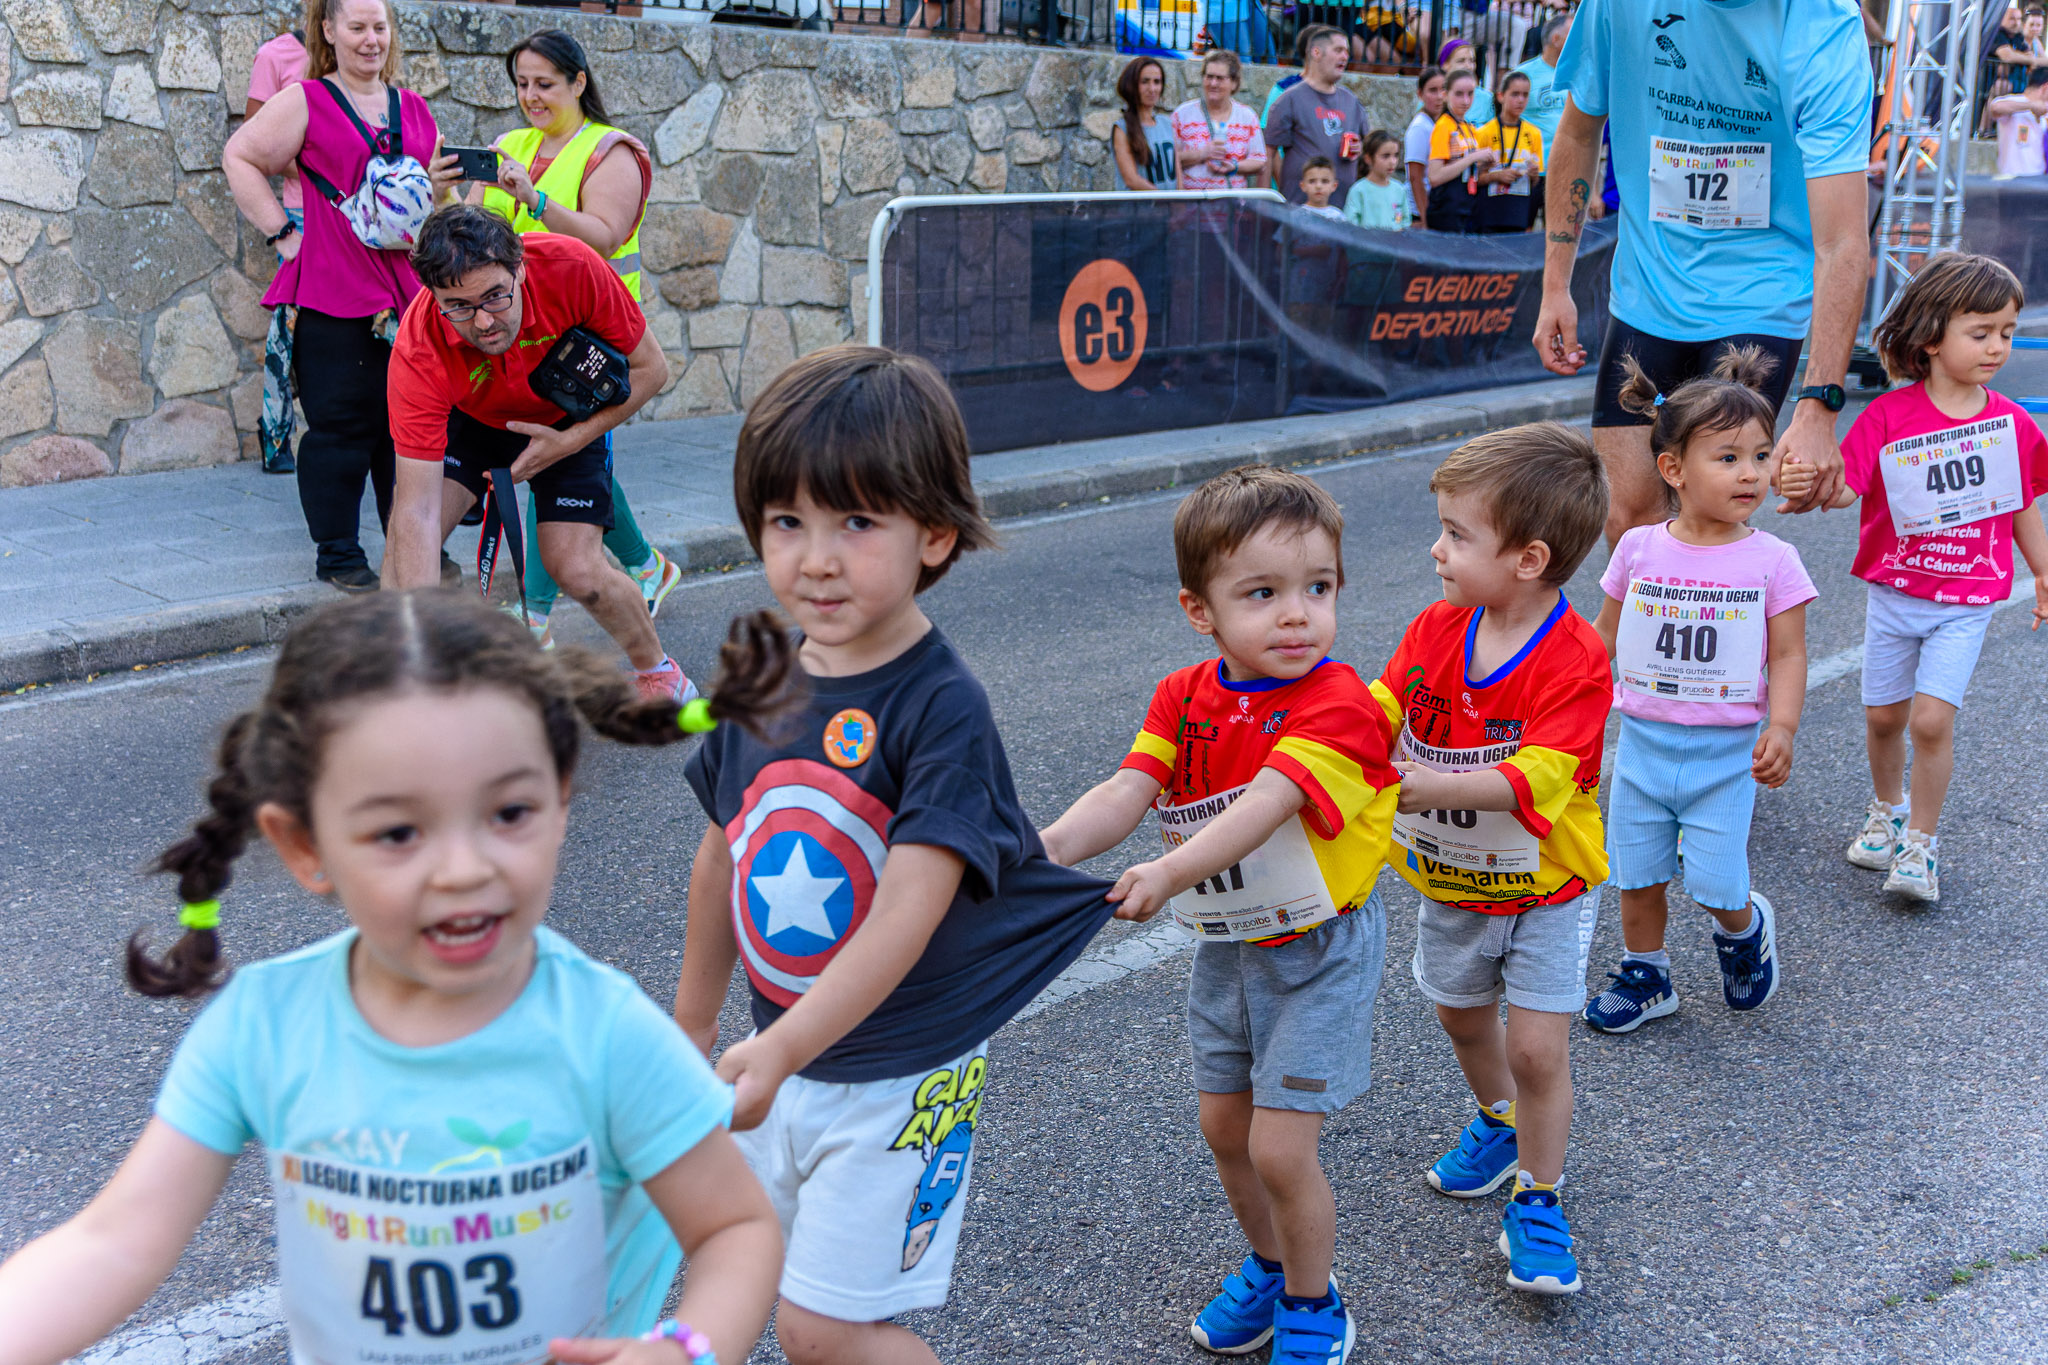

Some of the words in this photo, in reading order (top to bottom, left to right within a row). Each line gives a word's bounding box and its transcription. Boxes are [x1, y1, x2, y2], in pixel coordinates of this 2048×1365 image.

[1648, 86, 1655, 98] II
[1657, 89, 1704, 111] CARRERA
[1707, 101, 1773, 121] NOCTURNA
[1692, 116, 1705, 129] DE
[1663, 141, 1687, 153] LEGUA
[1689, 145, 1734, 156] NOCTURNA
[1736, 145, 1765, 154] UGENA
[1684, 173, 1729, 201] 172
[1404, 273, 1520, 303] EVENTOS
[1075, 286, 1135, 365] e3
[1369, 306, 1517, 341] DEPORTIVOS
[1895, 436, 1924, 453] LEGUA
[1926, 427, 1977, 445] NOCTURNA
[1978, 418, 2008, 434] UGENA
[1926, 455, 1985, 495] 409
[1920, 542, 1966, 555] contra
[1906, 555, 1920, 566] el
[1923, 556, 1974, 573] Cáncer
[1632, 582, 1639, 593] XI
[1639, 583, 1662, 598] LEGUA
[1664, 587, 1723, 603] NOCTURNA
[1726, 590, 1759, 602] UGENA
[1656, 622, 1717, 663] 410
[1647, 663, 1663, 672] AVRIL
[1664, 666, 1685, 674] LENIS
[1686, 667, 1726, 676] GUTIÉRREZ
[1414, 743, 1480, 765] NOCTURNA
[1160, 797, 1227, 825] NOCTURNA
[1429, 879, 1463, 892] Ventanas
[1464, 885, 1477, 895] que
[1496, 889, 1504, 898] el
[1231, 916, 1271, 930] grupoibc
[302, 1160, 361, 1197] LEGUA
[368, 1174, 502, 1205] NOCTURNA
[511, 1146, 589, 1195] UGENA
[361, 1253, 522, 1337] 403
